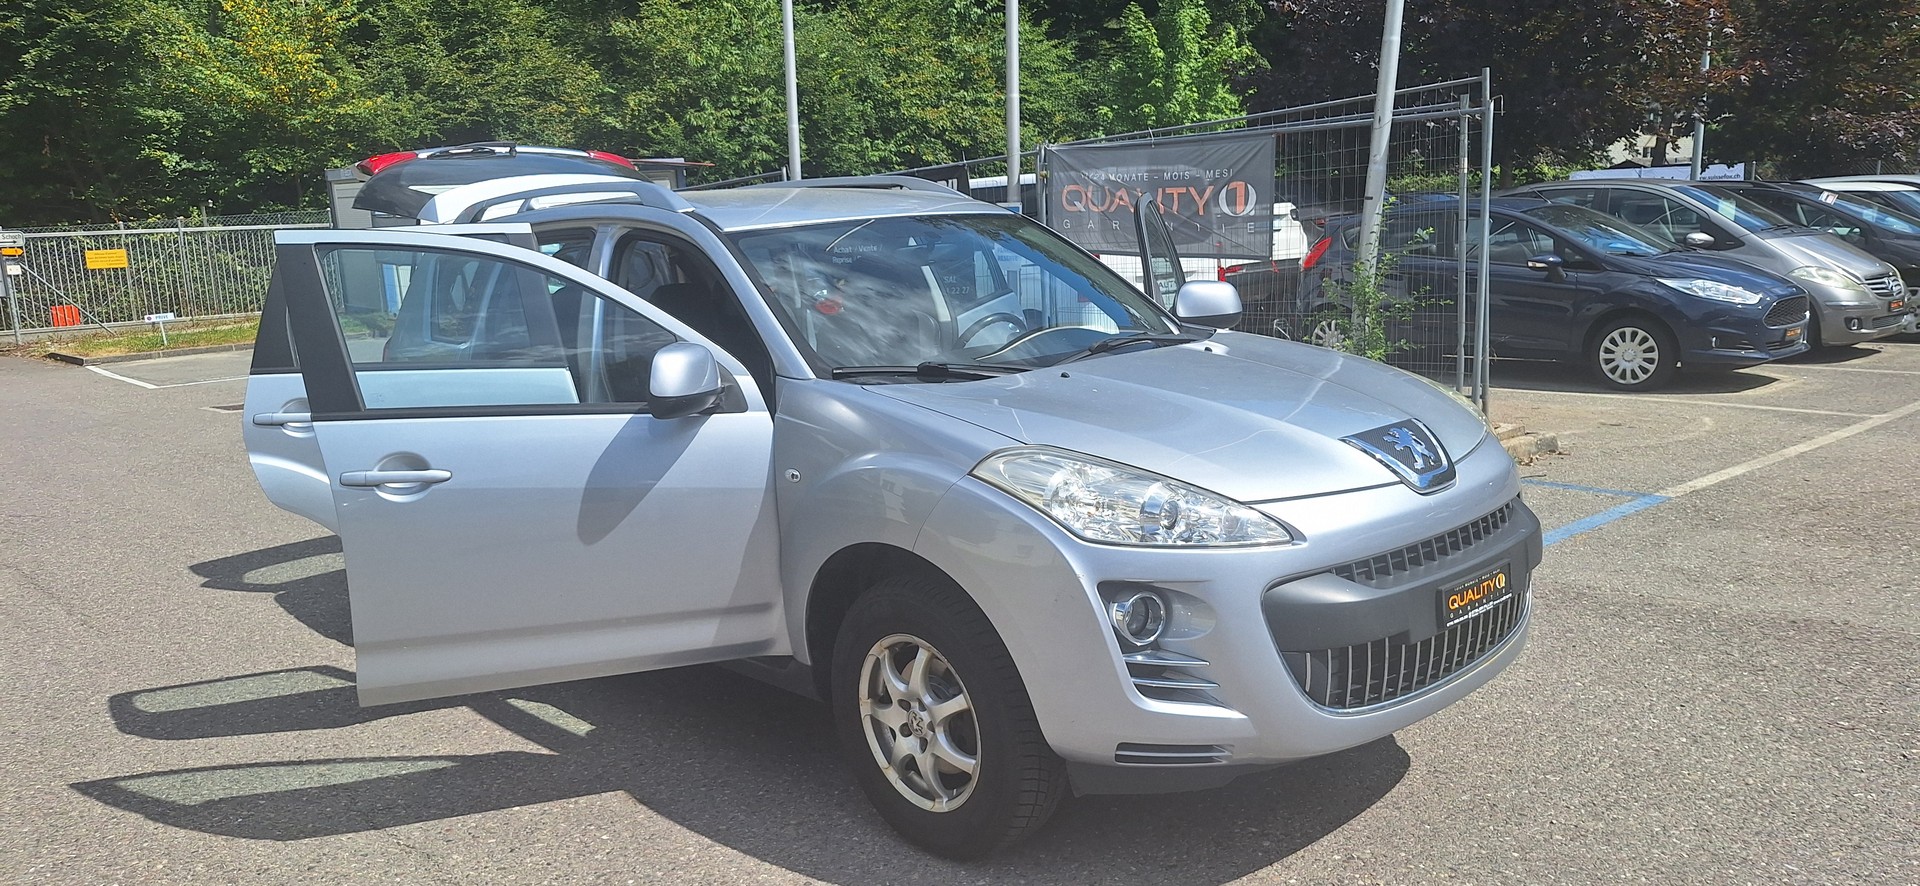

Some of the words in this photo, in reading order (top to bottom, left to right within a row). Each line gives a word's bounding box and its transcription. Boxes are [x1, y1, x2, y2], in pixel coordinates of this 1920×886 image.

[1109, 173, 1149, 181] MONATE
[1164, 171, 1190, 180] MOIS
[1205, 168, 1233, 178] MESI
[1062, 183, 1215, 216] QUAITY
[1063, 219, 1255, 234] GARNTIE
[1448, 577, 1496, 610] QUALITY
